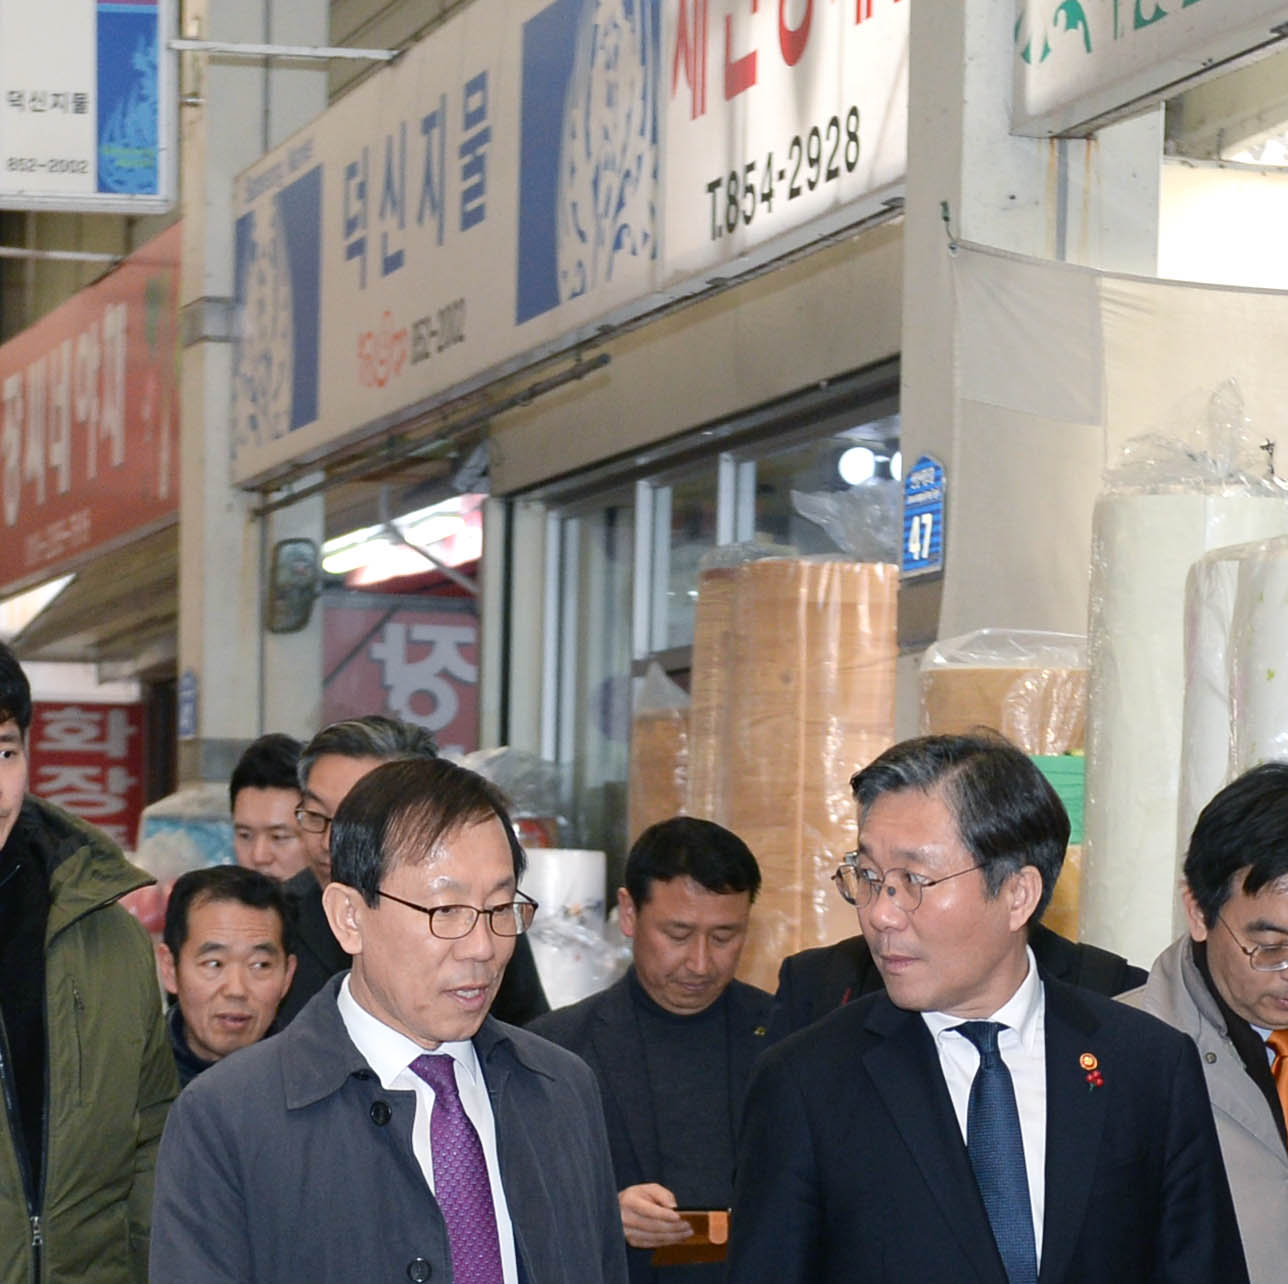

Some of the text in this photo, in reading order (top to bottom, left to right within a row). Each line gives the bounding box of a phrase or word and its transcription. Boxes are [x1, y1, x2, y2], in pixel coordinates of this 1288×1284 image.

[7, 89, 90, 115] 덕신지물
[344, 69, 493, 290] 덕신지물
[705, 105, 861, 241] T.854-2928
[908, 513, 933, 560] 47
